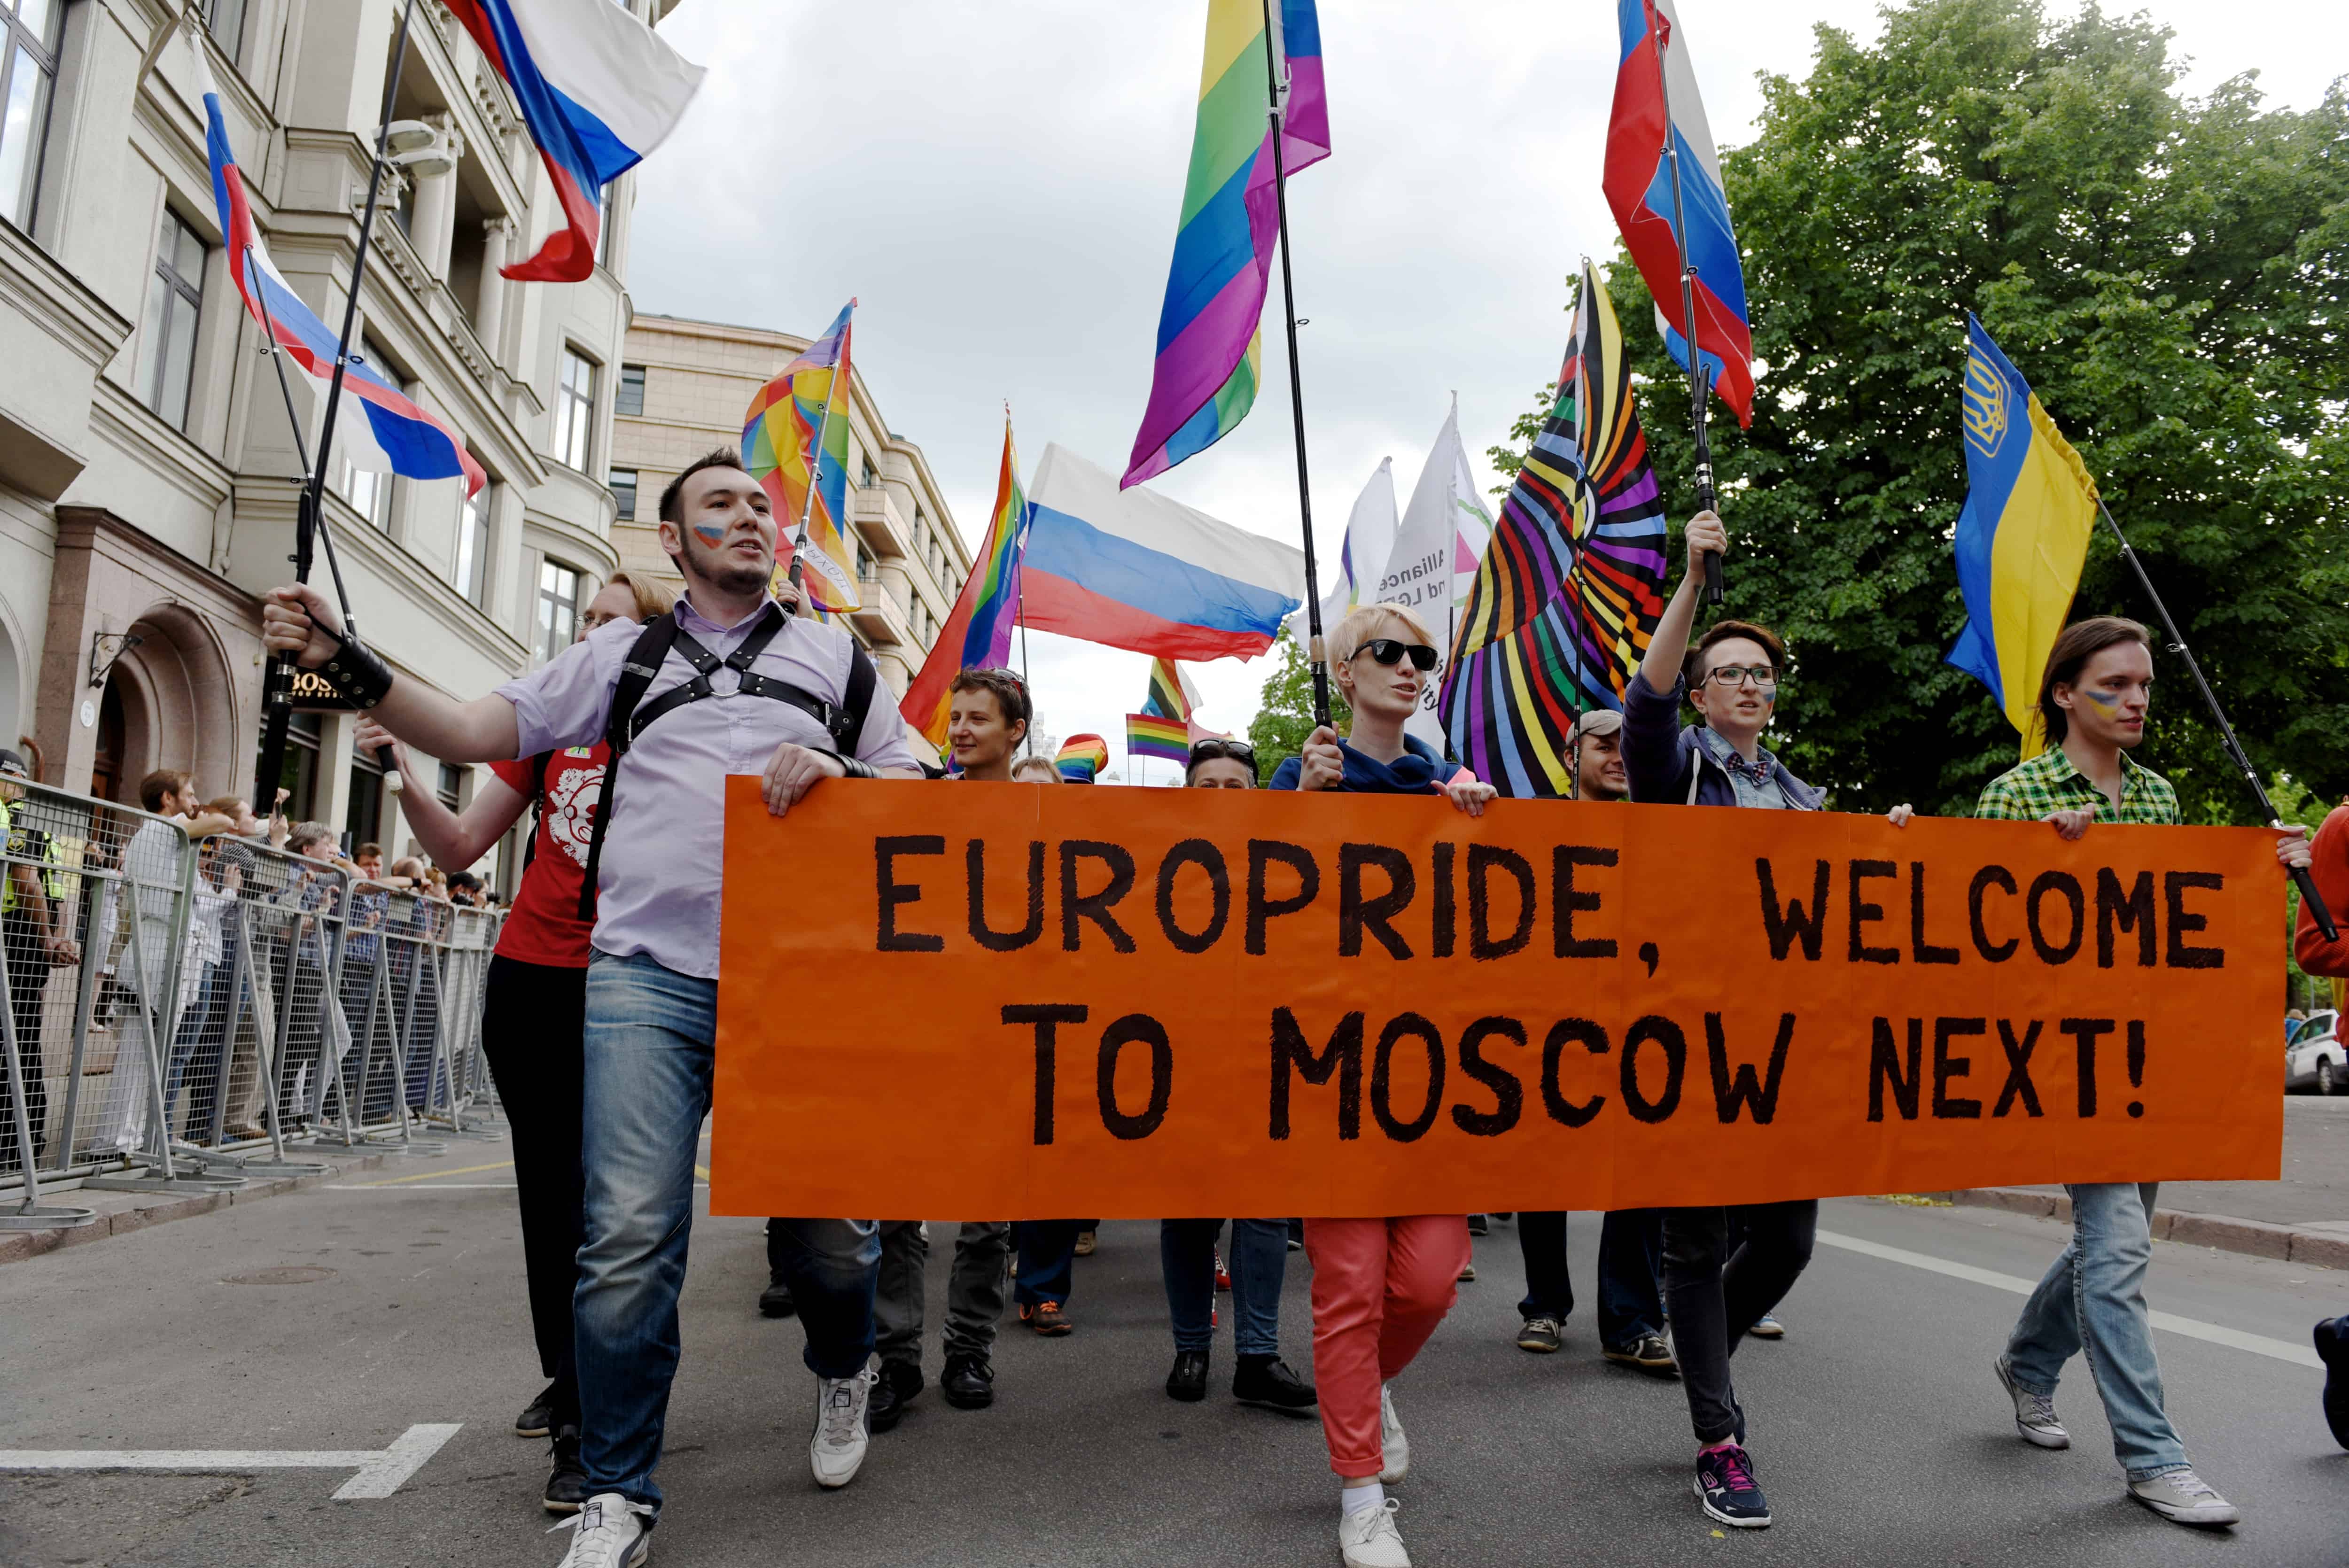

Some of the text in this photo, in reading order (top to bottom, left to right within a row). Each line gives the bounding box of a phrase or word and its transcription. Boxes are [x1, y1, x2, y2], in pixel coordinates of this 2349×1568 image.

[875, 835, 2225, 978] EUROPRIDE, WELCOME
[1000, 1003, 2146, 1146] TO MOSCOW NEXT!
